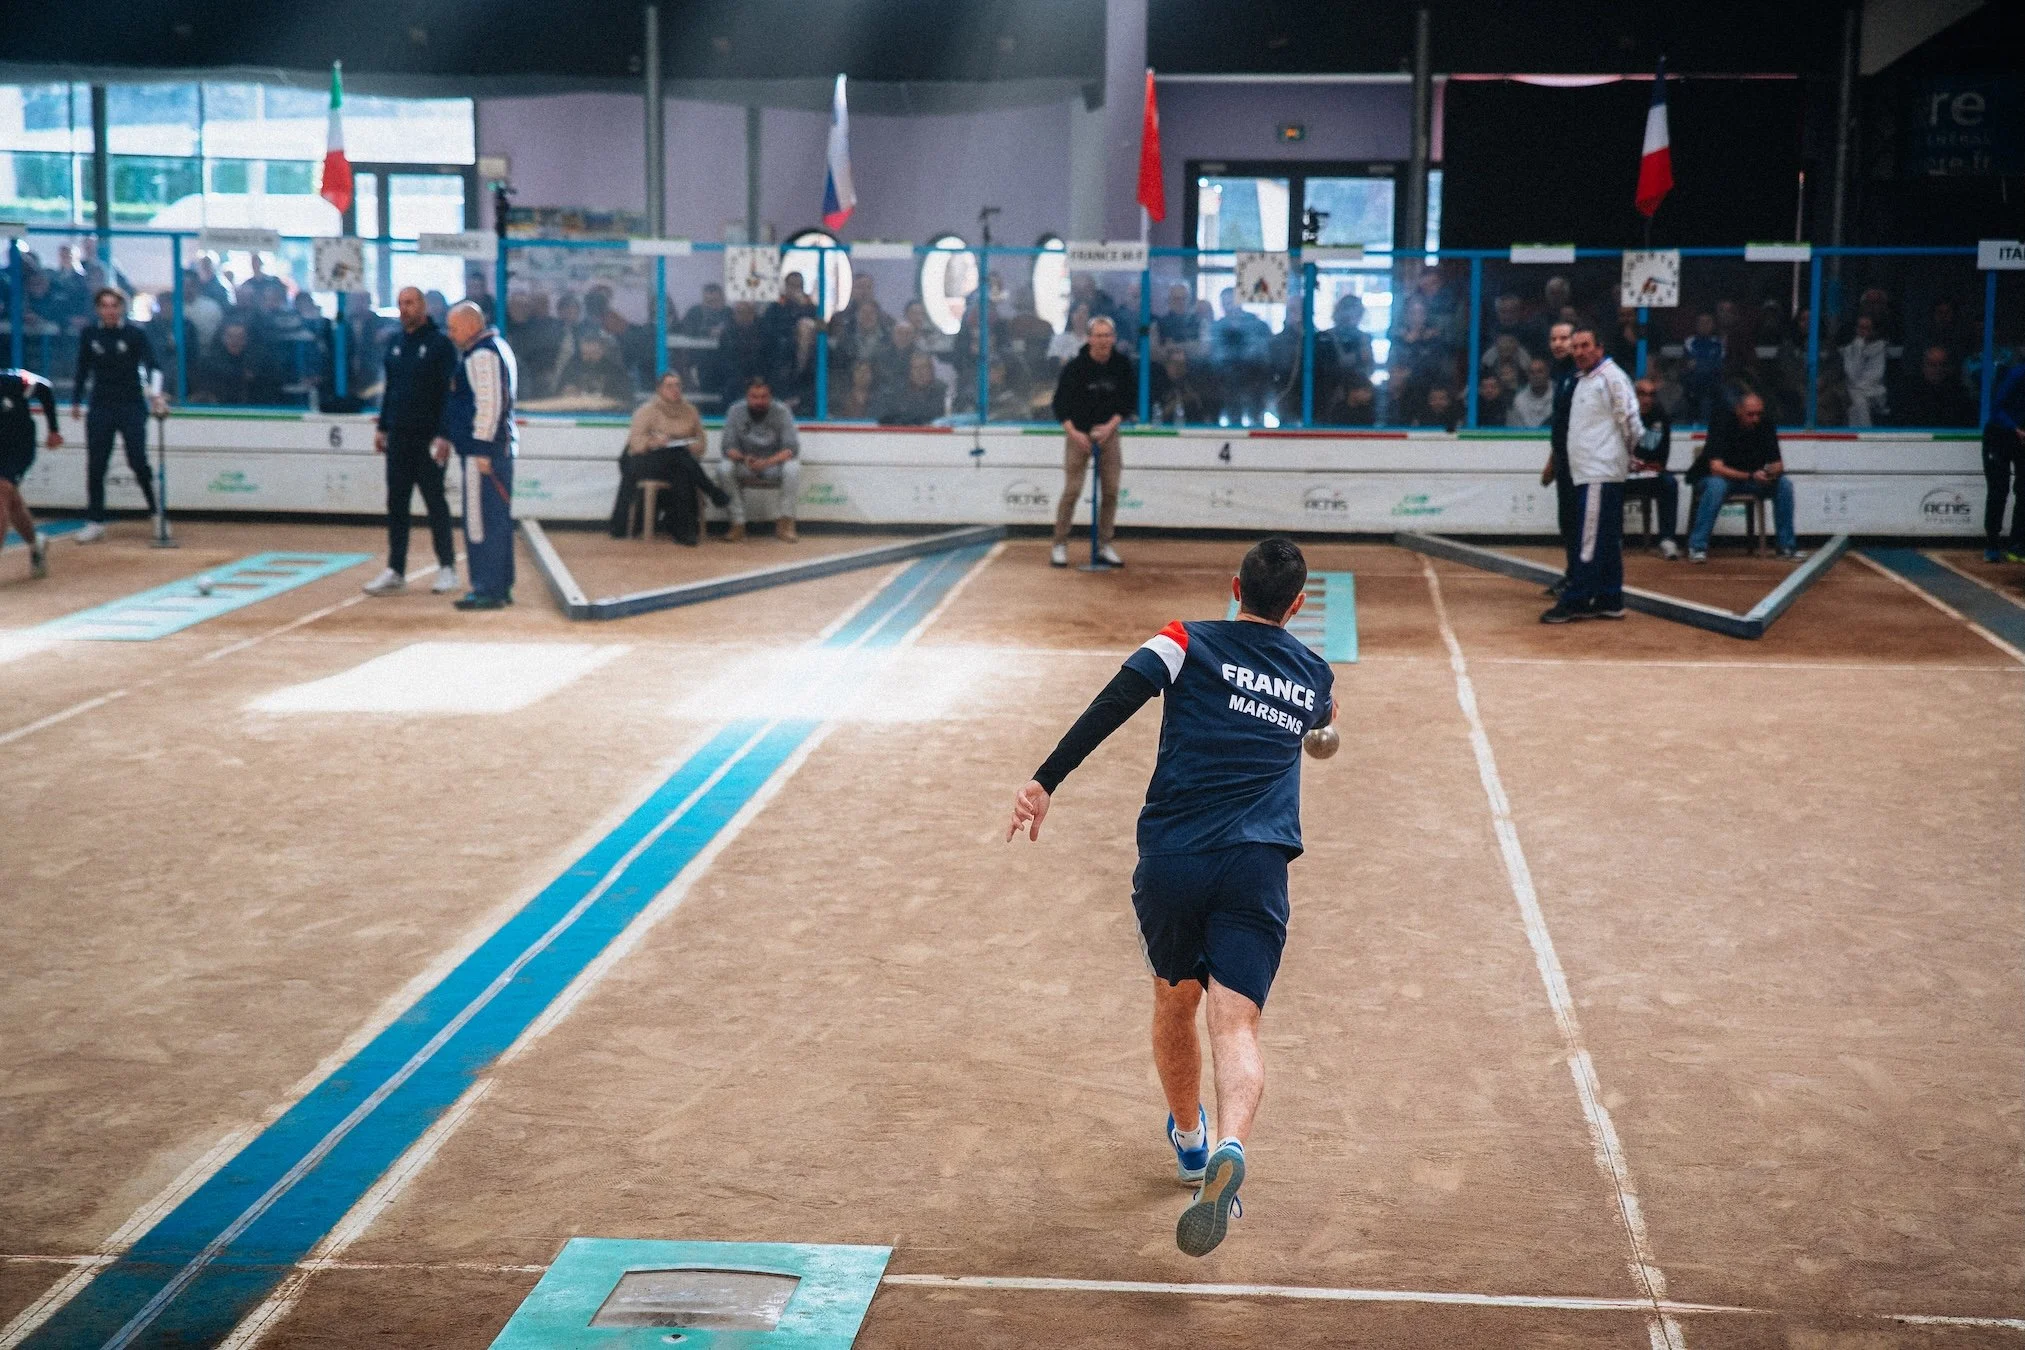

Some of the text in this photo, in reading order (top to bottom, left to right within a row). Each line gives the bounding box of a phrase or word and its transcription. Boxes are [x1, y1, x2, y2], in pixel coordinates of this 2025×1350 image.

[1071, 250, 1118, 261] FRANCE
[1998, 247, 2025, 261] ITA
[327, 424, 343, 448] 6
[1218, 442, 1232, 463] 4
[1221, 663, 1316, 712] FRANCE
[1228, 694, 1304, 736] MARSENS
